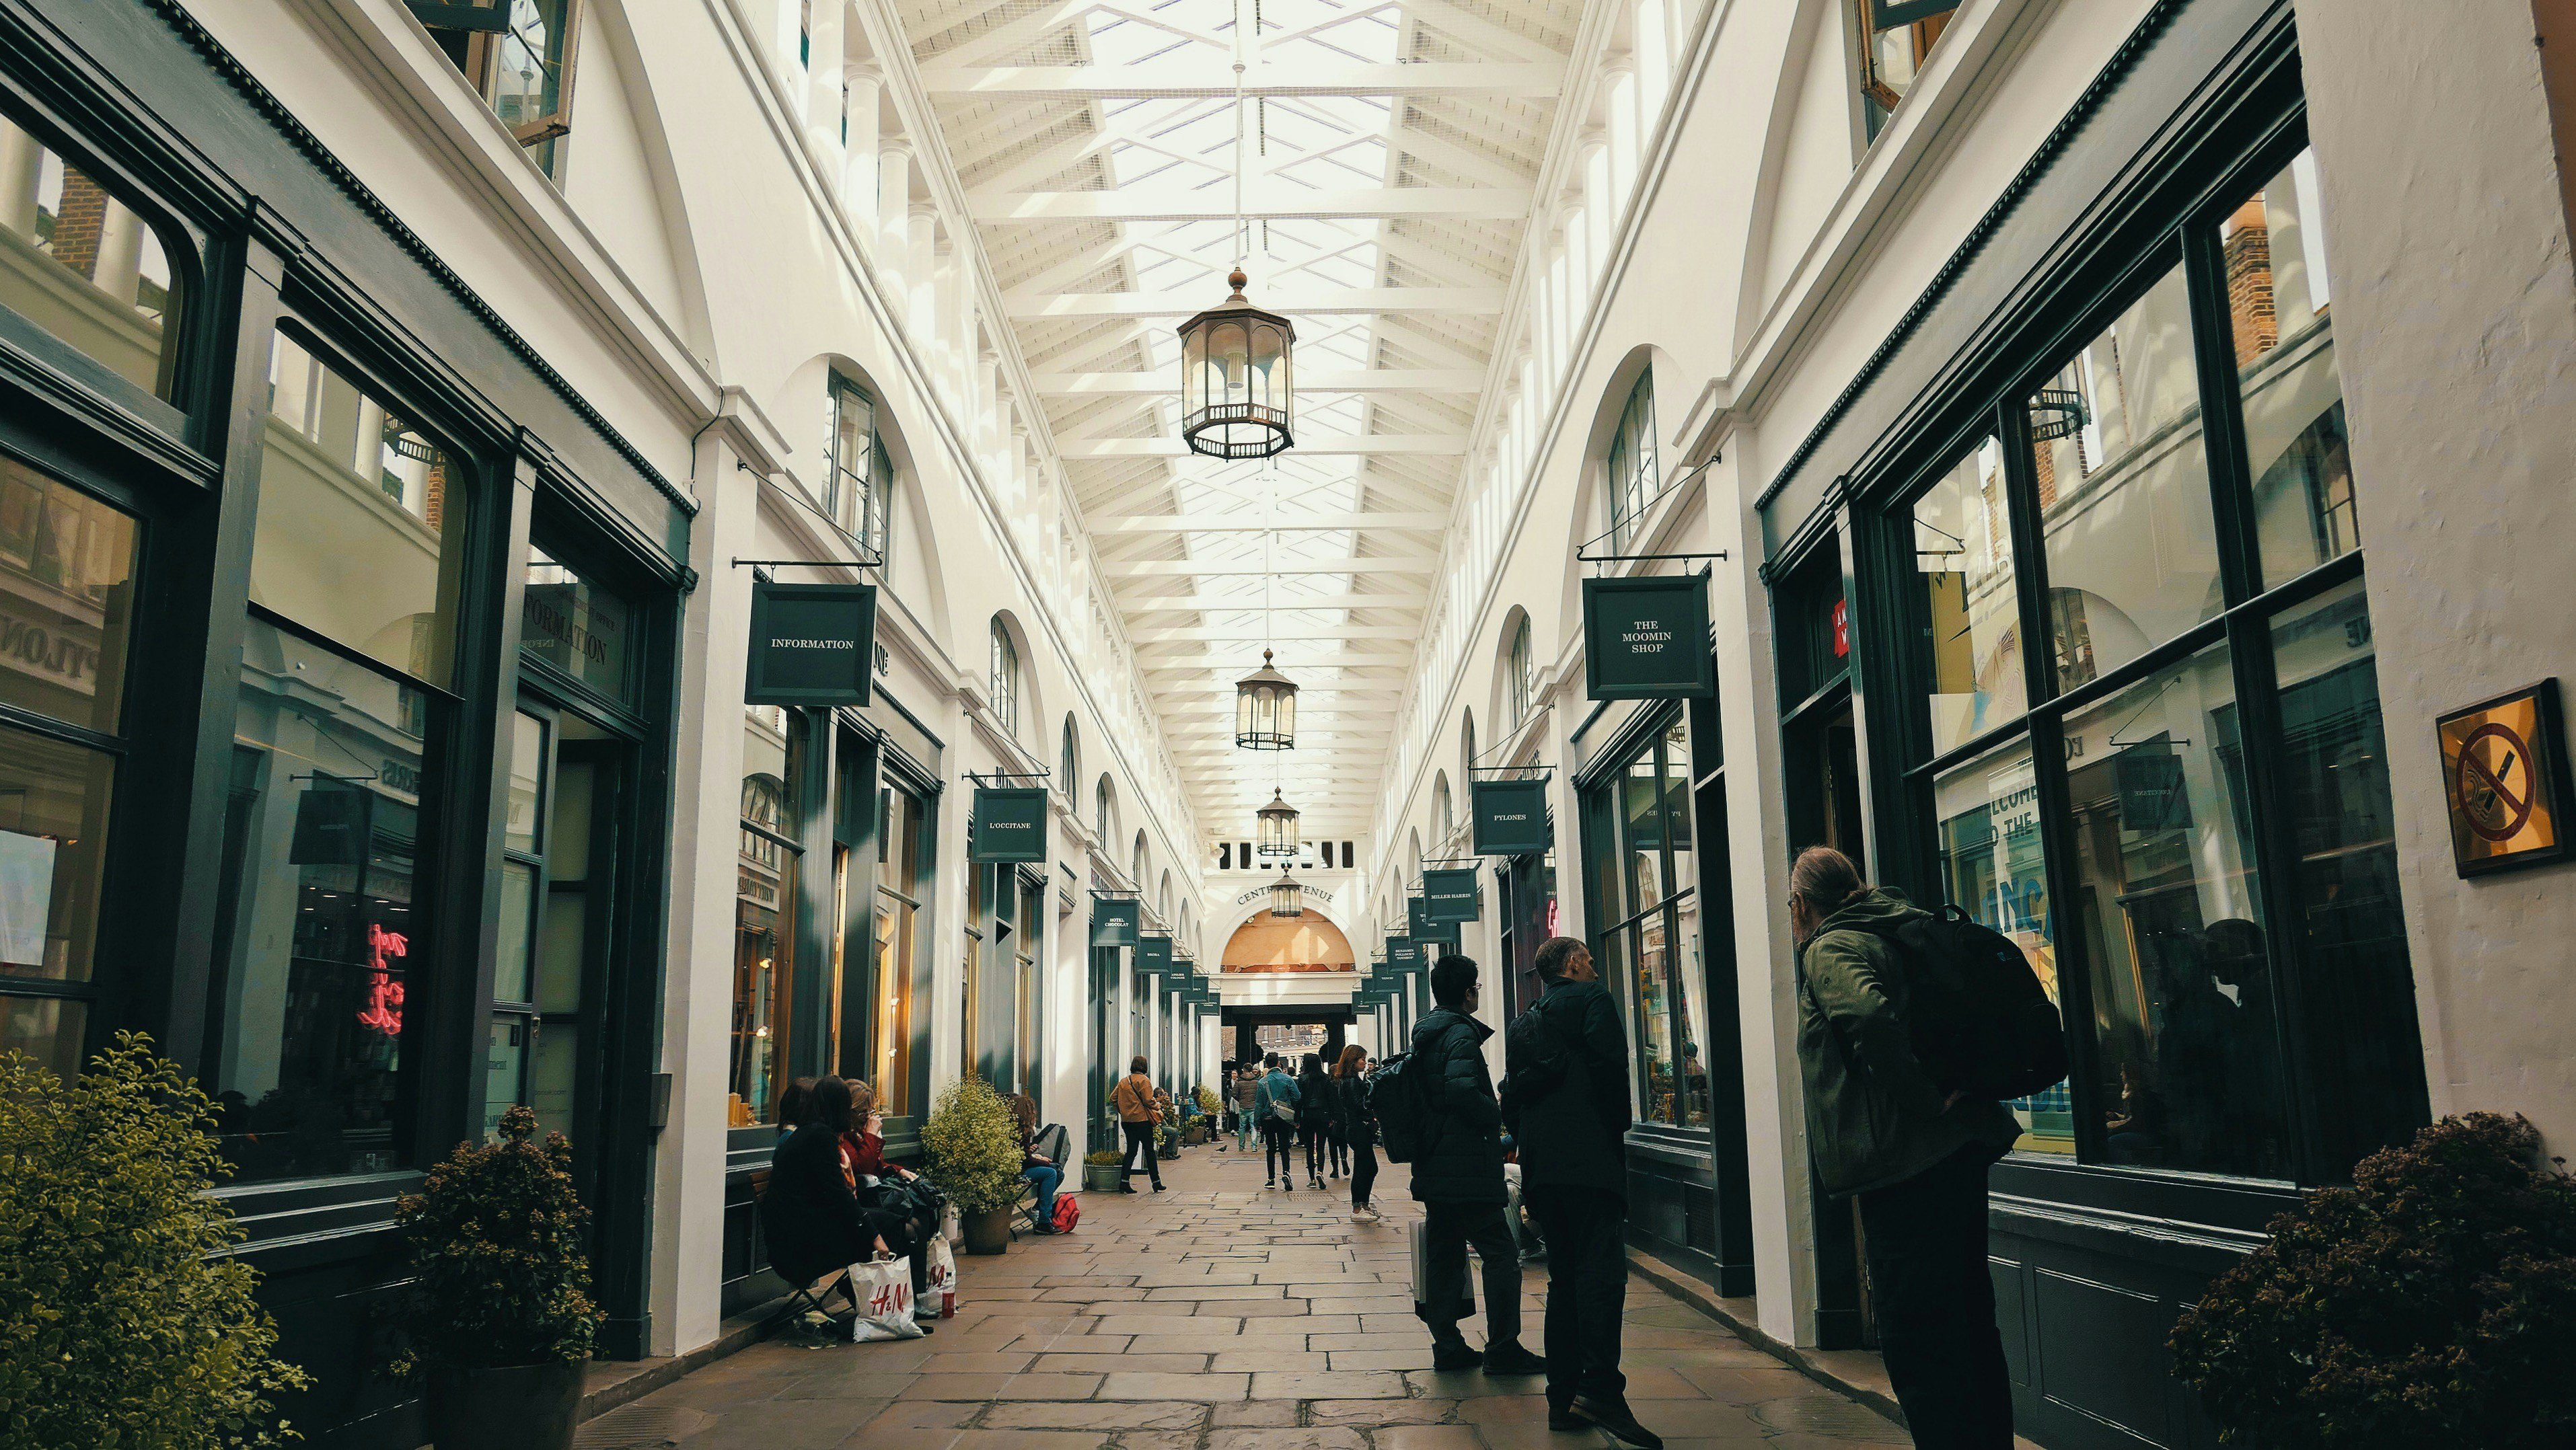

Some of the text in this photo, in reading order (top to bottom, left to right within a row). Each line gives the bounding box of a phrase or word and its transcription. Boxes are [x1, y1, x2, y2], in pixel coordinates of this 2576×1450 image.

[1634, 620, 1658, 629] THE
[1622, 632, 1672, 642] MOOMIN
[771, 638, 854, 649] INFORMATION
[1631, 644, 1664, 653] SHOP
[2003, 811, 2033, 841] THE
[1238, 886, 1334, 905] CENTR ENUE
[870, 1283, 908, 1316] H&M
